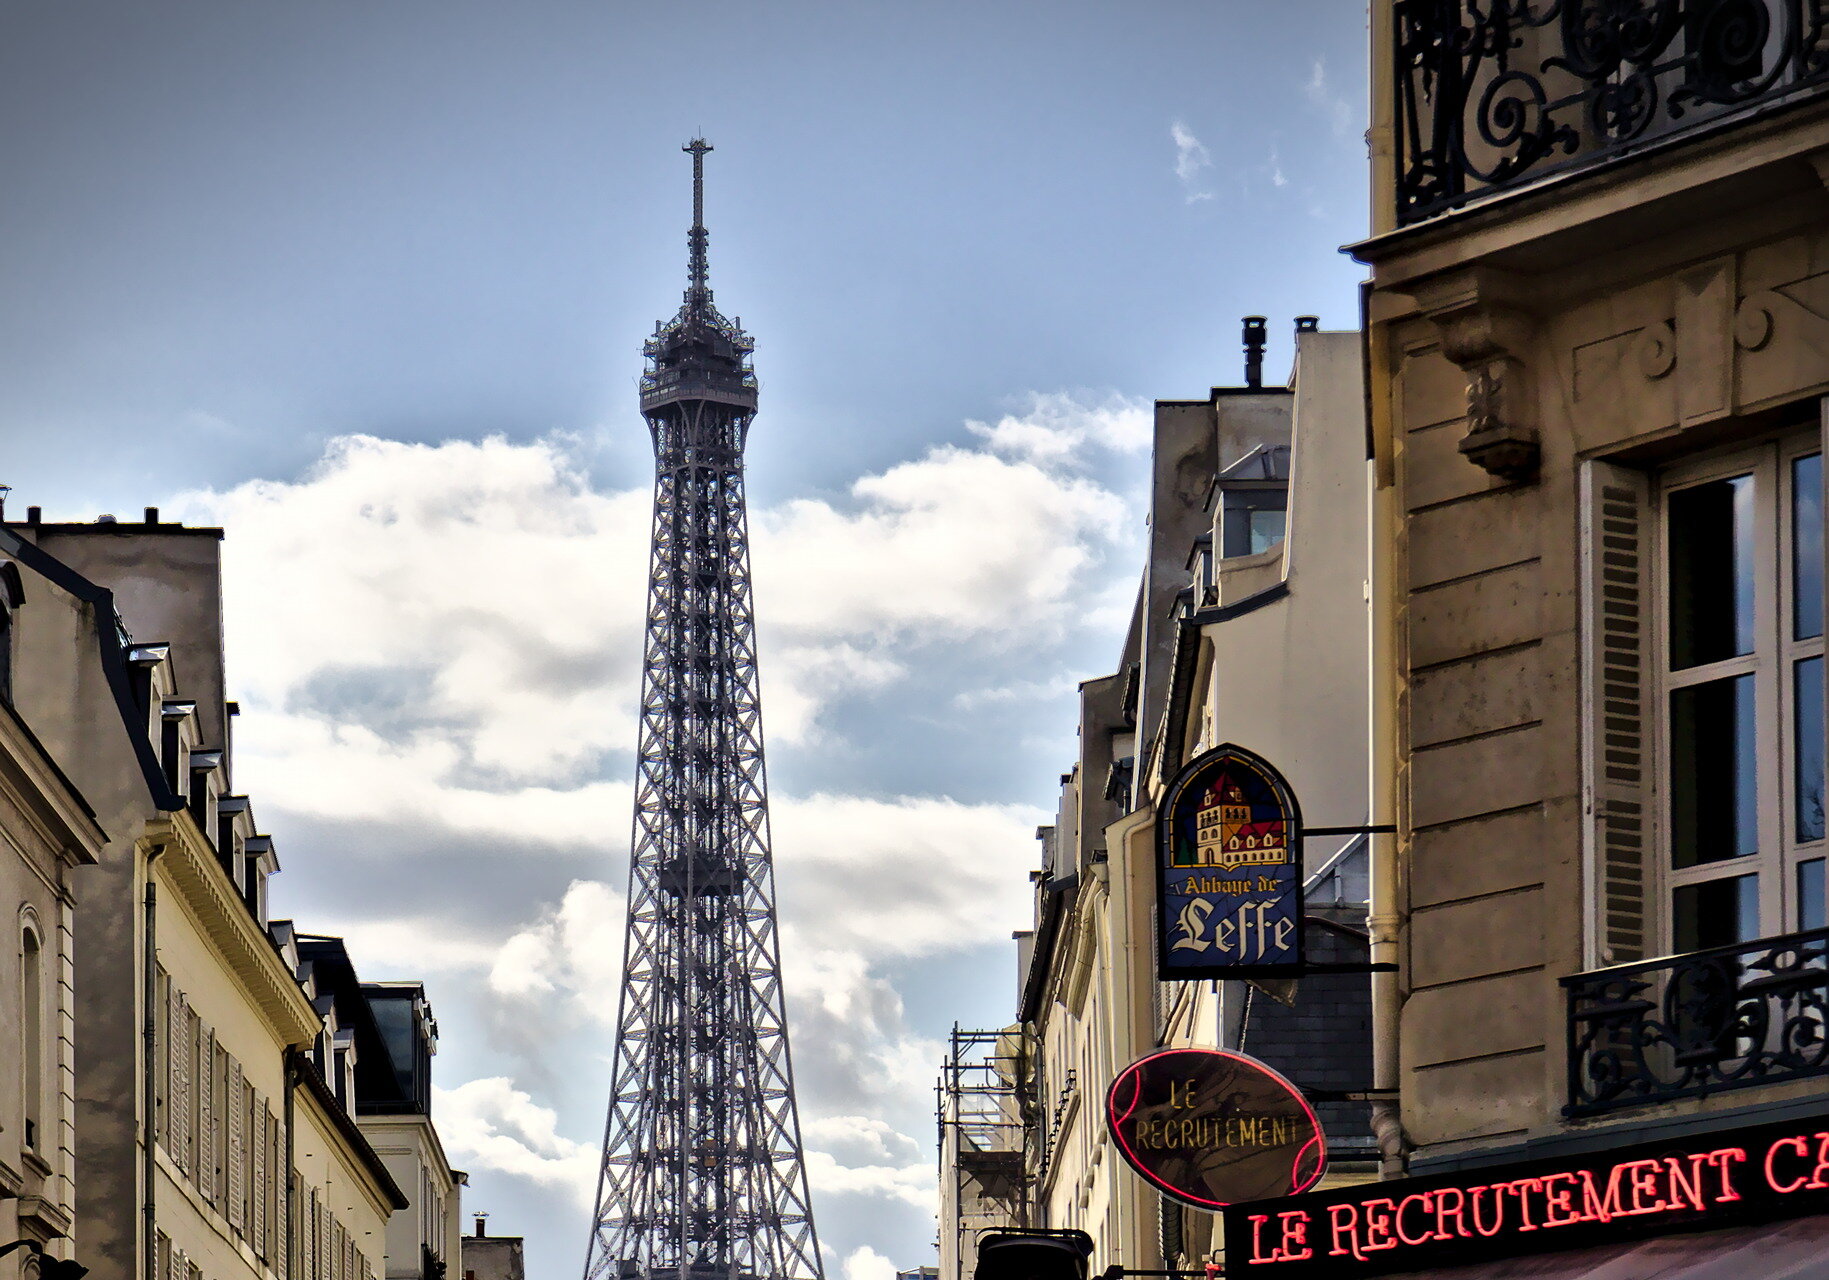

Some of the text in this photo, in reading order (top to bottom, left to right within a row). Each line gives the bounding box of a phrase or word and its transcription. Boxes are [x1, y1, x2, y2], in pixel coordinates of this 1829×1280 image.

[1184, 875, 1282, 897] Abbaye de
[1170, 896, 1296, 962] Leffe
[1169, 1078, 1198, 1110] LE
[1135, 1113, 1300, 1150] RECRUTEMENT
[1248, 1208, 1313, 1264] LE
[1327, 1147, 1748, 1262] RECRUTEMENT
